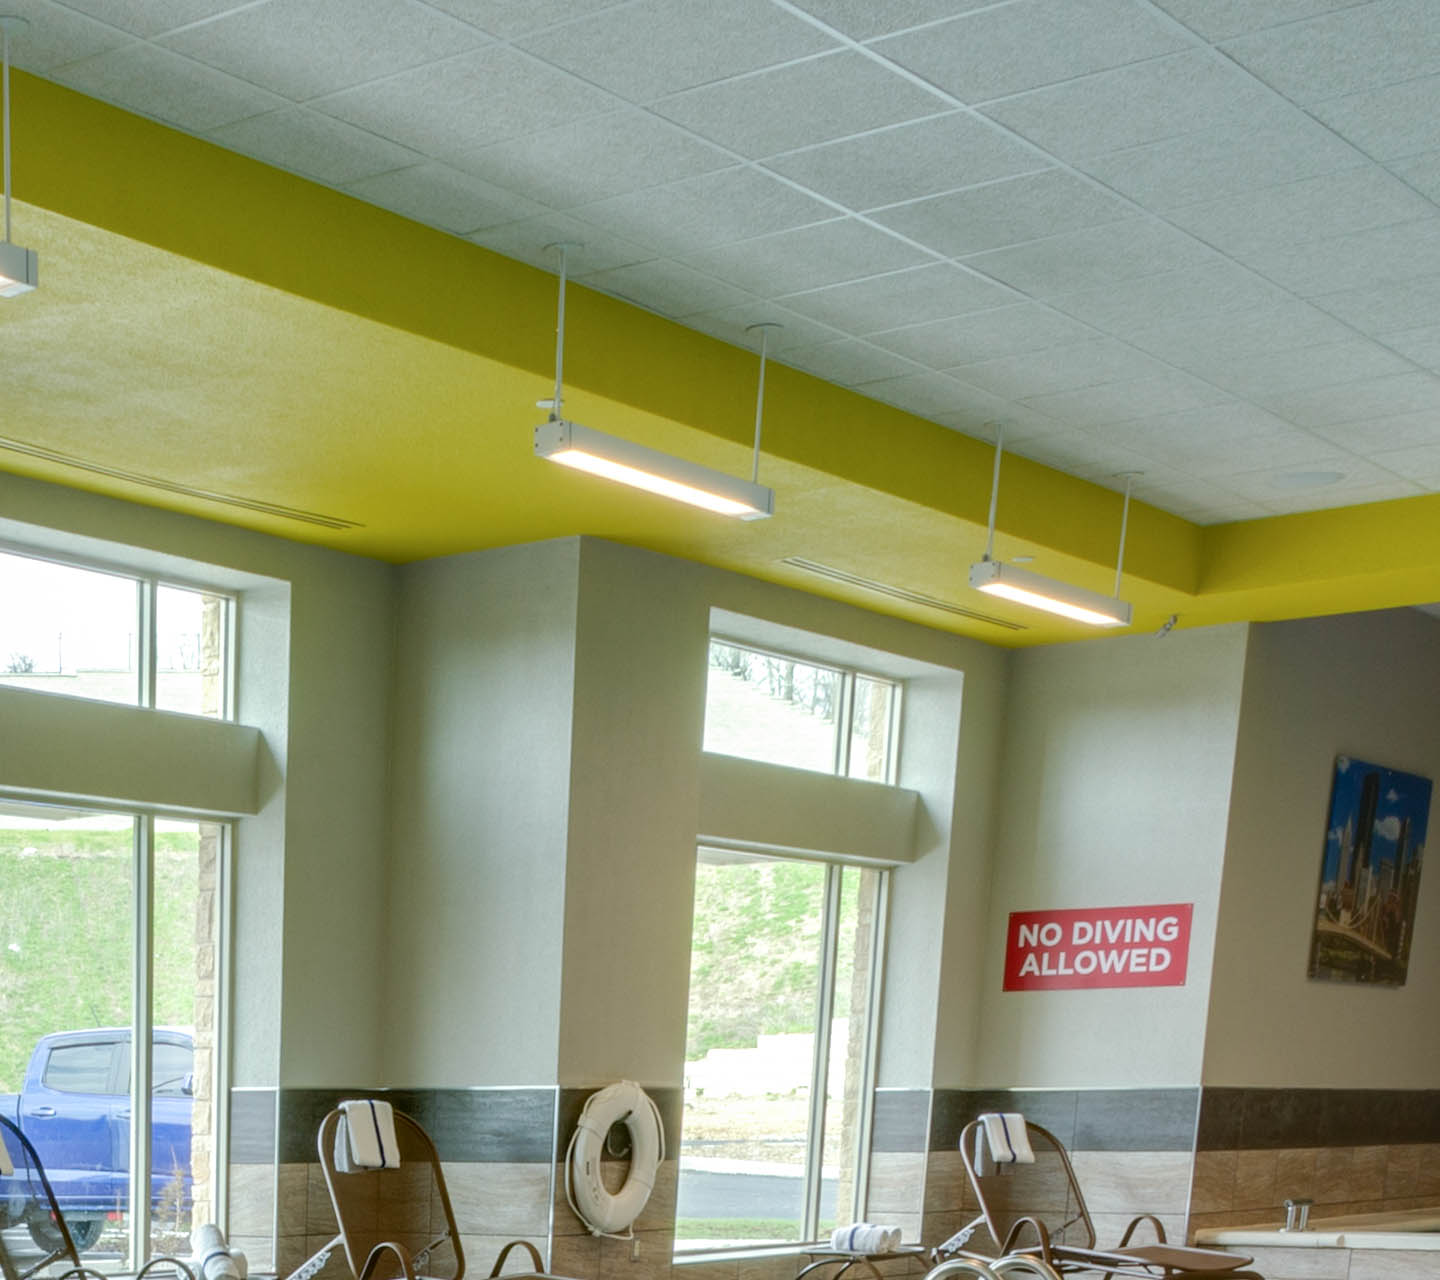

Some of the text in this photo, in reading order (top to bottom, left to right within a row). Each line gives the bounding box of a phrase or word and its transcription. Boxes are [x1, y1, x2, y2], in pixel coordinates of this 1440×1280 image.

[1018, 916, 1180, 948] NO DIVING
[1018, 947, 1172, 977] ALLOWED
